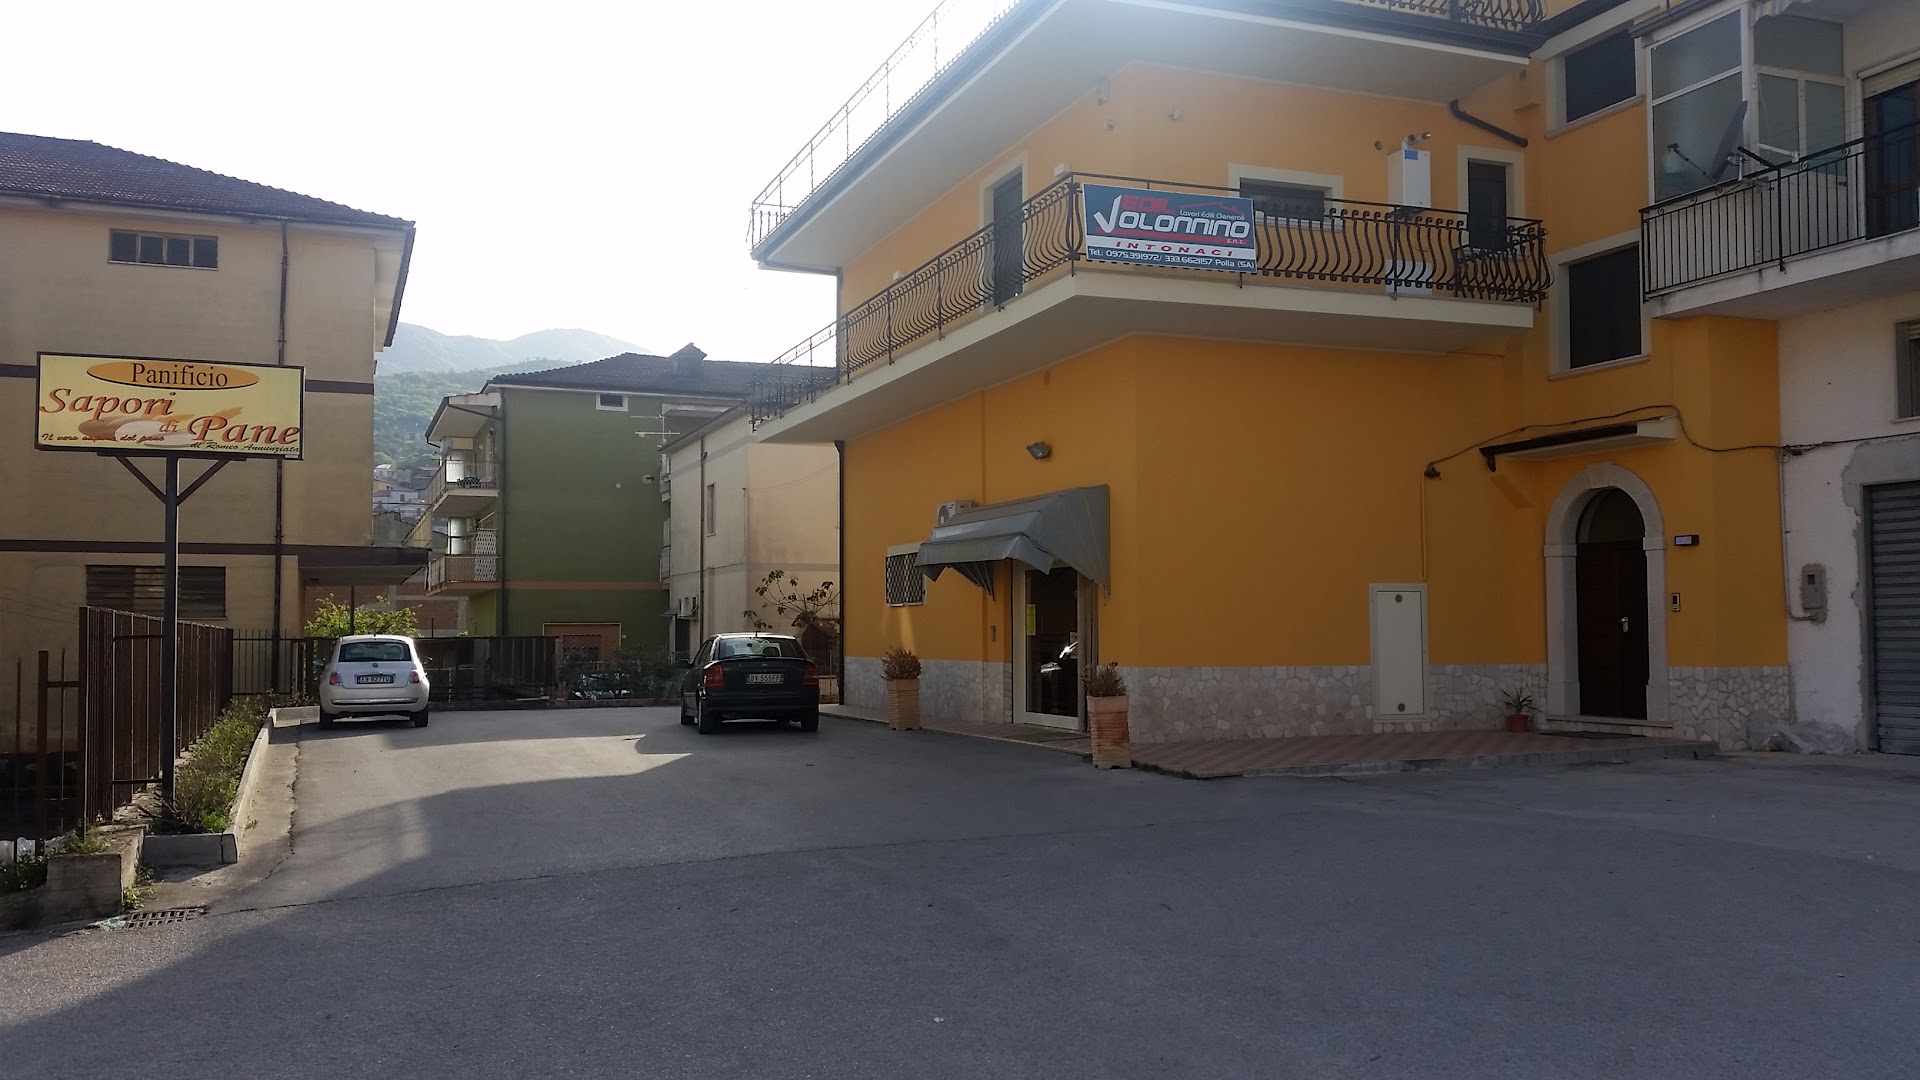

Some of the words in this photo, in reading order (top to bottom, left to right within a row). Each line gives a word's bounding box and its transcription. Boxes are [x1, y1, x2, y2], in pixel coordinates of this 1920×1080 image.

[1121, 195, 1175, 214] EDIL
[1179, 209, 1200, 217] Lavori
[1216, 212, 1245, 221] Generali
[1088, 248, 1104, 256] Tel.:
[1215, 259, 1235, 267] Polla
[1237, 261, 1255, 269] (SA)
[1115, 241, 1233, 257] INTONACI
[131, 363, 228, 387] Panificio
[39, 388, 177, 422] Sapori
[41, 433, 53, 441] Il
[119, 434, 136, 442] del
[136, 435, 165, 444] pane
[158, 419, 179, 433] di
[187, 415, 300, 445] Pane
[205, 441, 239, 450] Romeo
[241, 443, 299, 454] Annunziata
